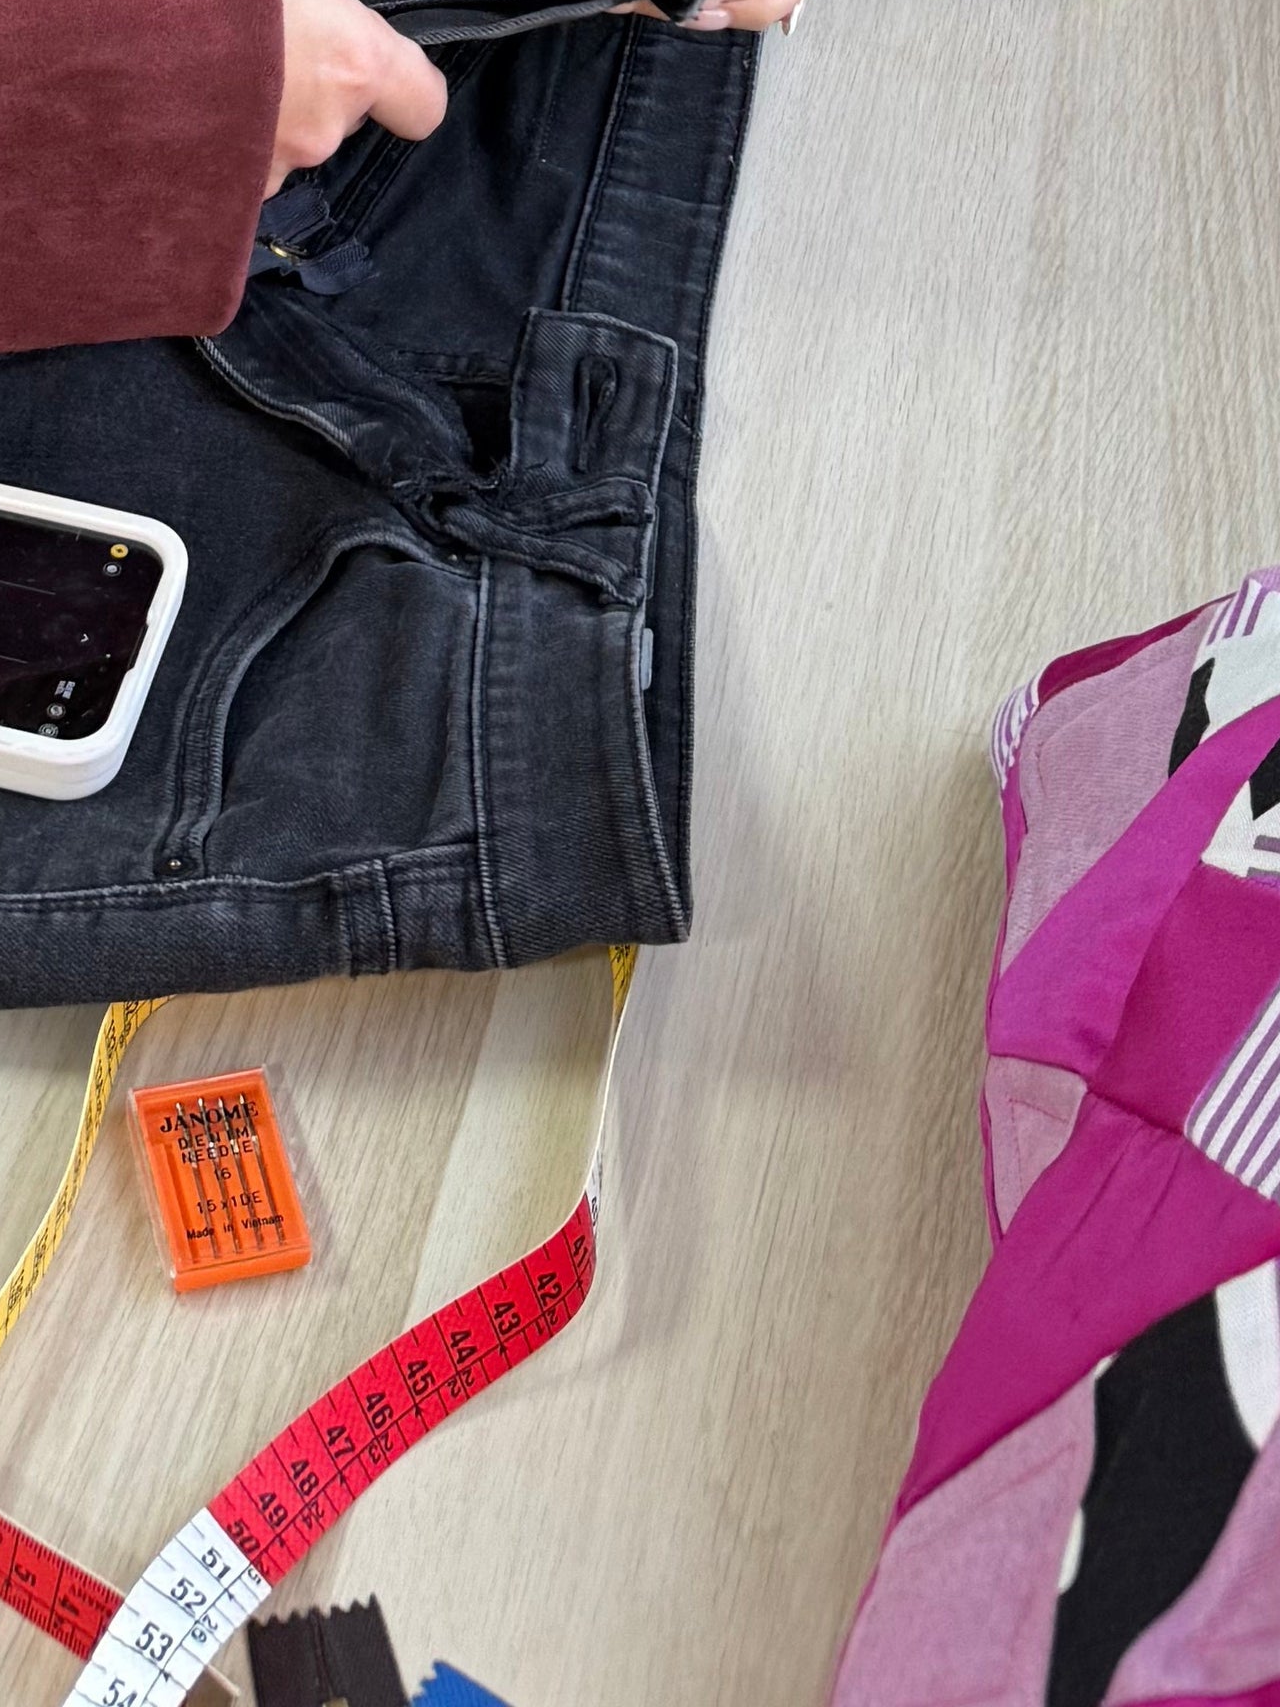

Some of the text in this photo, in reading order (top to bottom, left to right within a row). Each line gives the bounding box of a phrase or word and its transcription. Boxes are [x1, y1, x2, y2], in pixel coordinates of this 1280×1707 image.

[160, 1101, 258, 1132] JANOME
[178, 1126, 250, 1151] DENIM
[181, 1139, 253, 1164] NEEDLE
[215, 1167, 231, 1181] 16
[186, 1213, 284, 1240] Made in Vietnam
[573, 1235, 589, 1268] 41
[537, 1271, 563, 1307] 42
[493, 1301, 521, 1336] 43
[450, 1329, 478, 1364] 44
[407, 1359, 436, 1397] 45
[447, 1369, 474, 1398] 22
[366, 1391, 394, 1429] 46
[326, 1425, 356, 1459] 47
[368, 1432, 394, 1464] 23
[291, 1459, 320, 1496] 48
[258, 1492, 289, 1528] 49
[226, 1518, 261, 1554] 50
[14, 1563, 36, 1586] 5
[201, 1546, 232, 1580] 51
[170, 1577, 207, 1616] 52
[135, 1621, 174, 1662] 53
